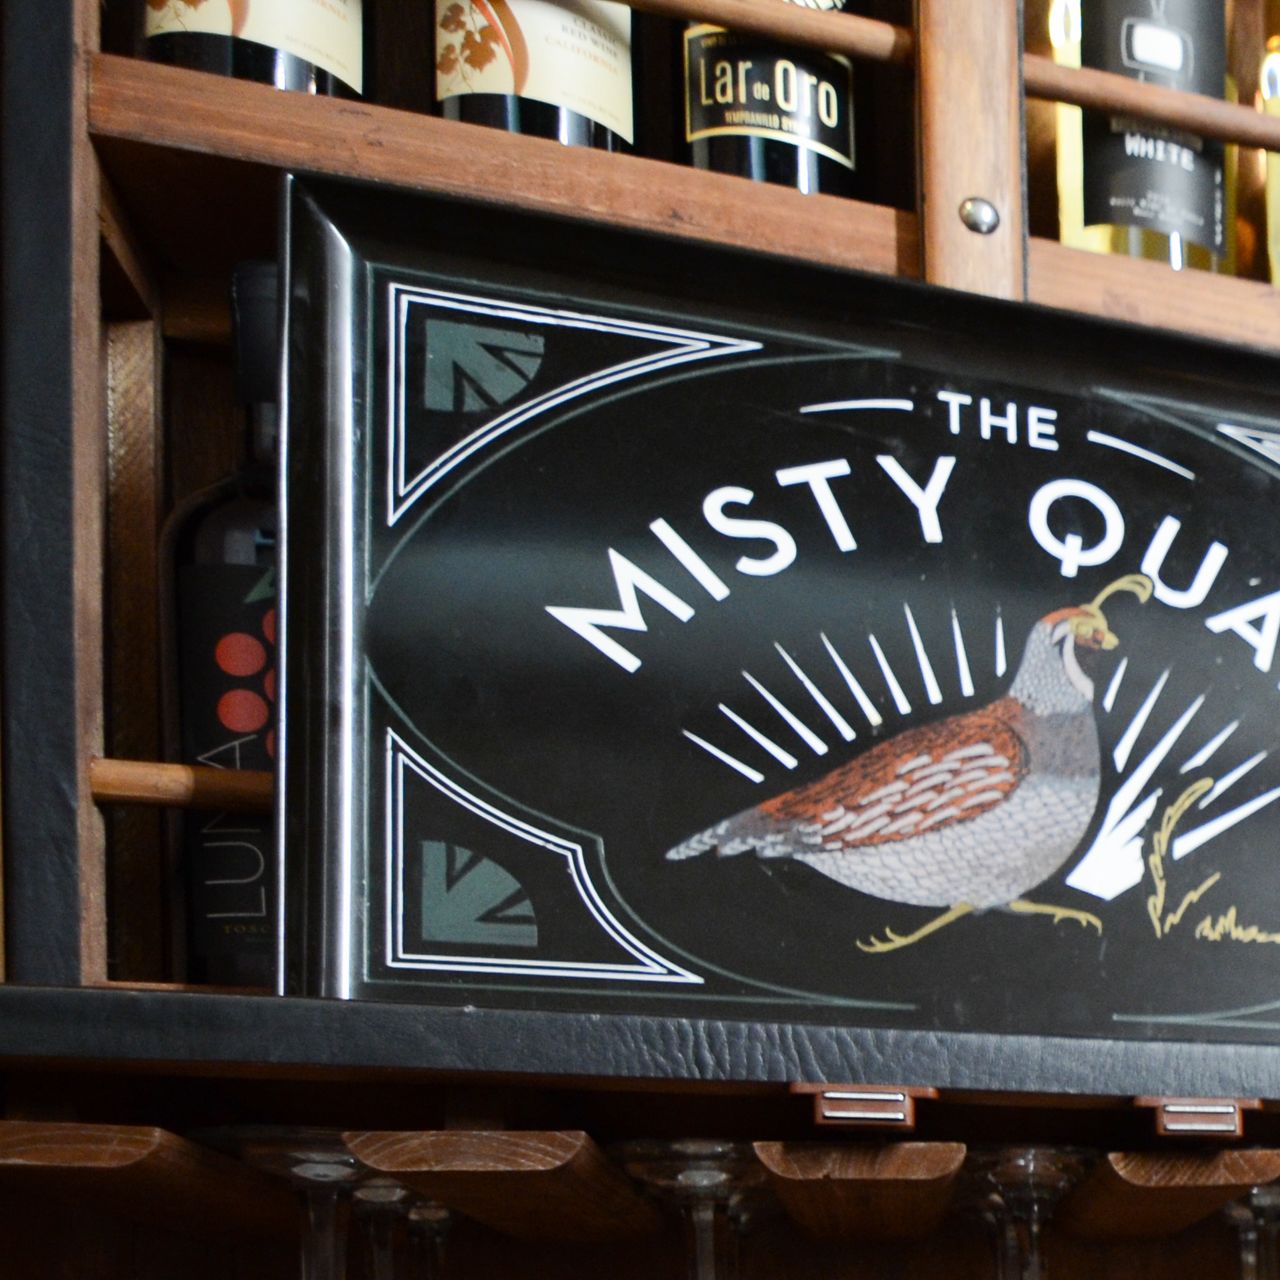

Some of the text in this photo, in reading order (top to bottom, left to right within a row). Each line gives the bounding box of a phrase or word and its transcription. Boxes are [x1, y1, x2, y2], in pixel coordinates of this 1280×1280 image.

[700, 57, 839, 129] Lar de Oro
[1124, 132, 1195, 172] WHITE
[937, 391, 1059, 451] THE
[544, 455, 957, 674] MISTY
